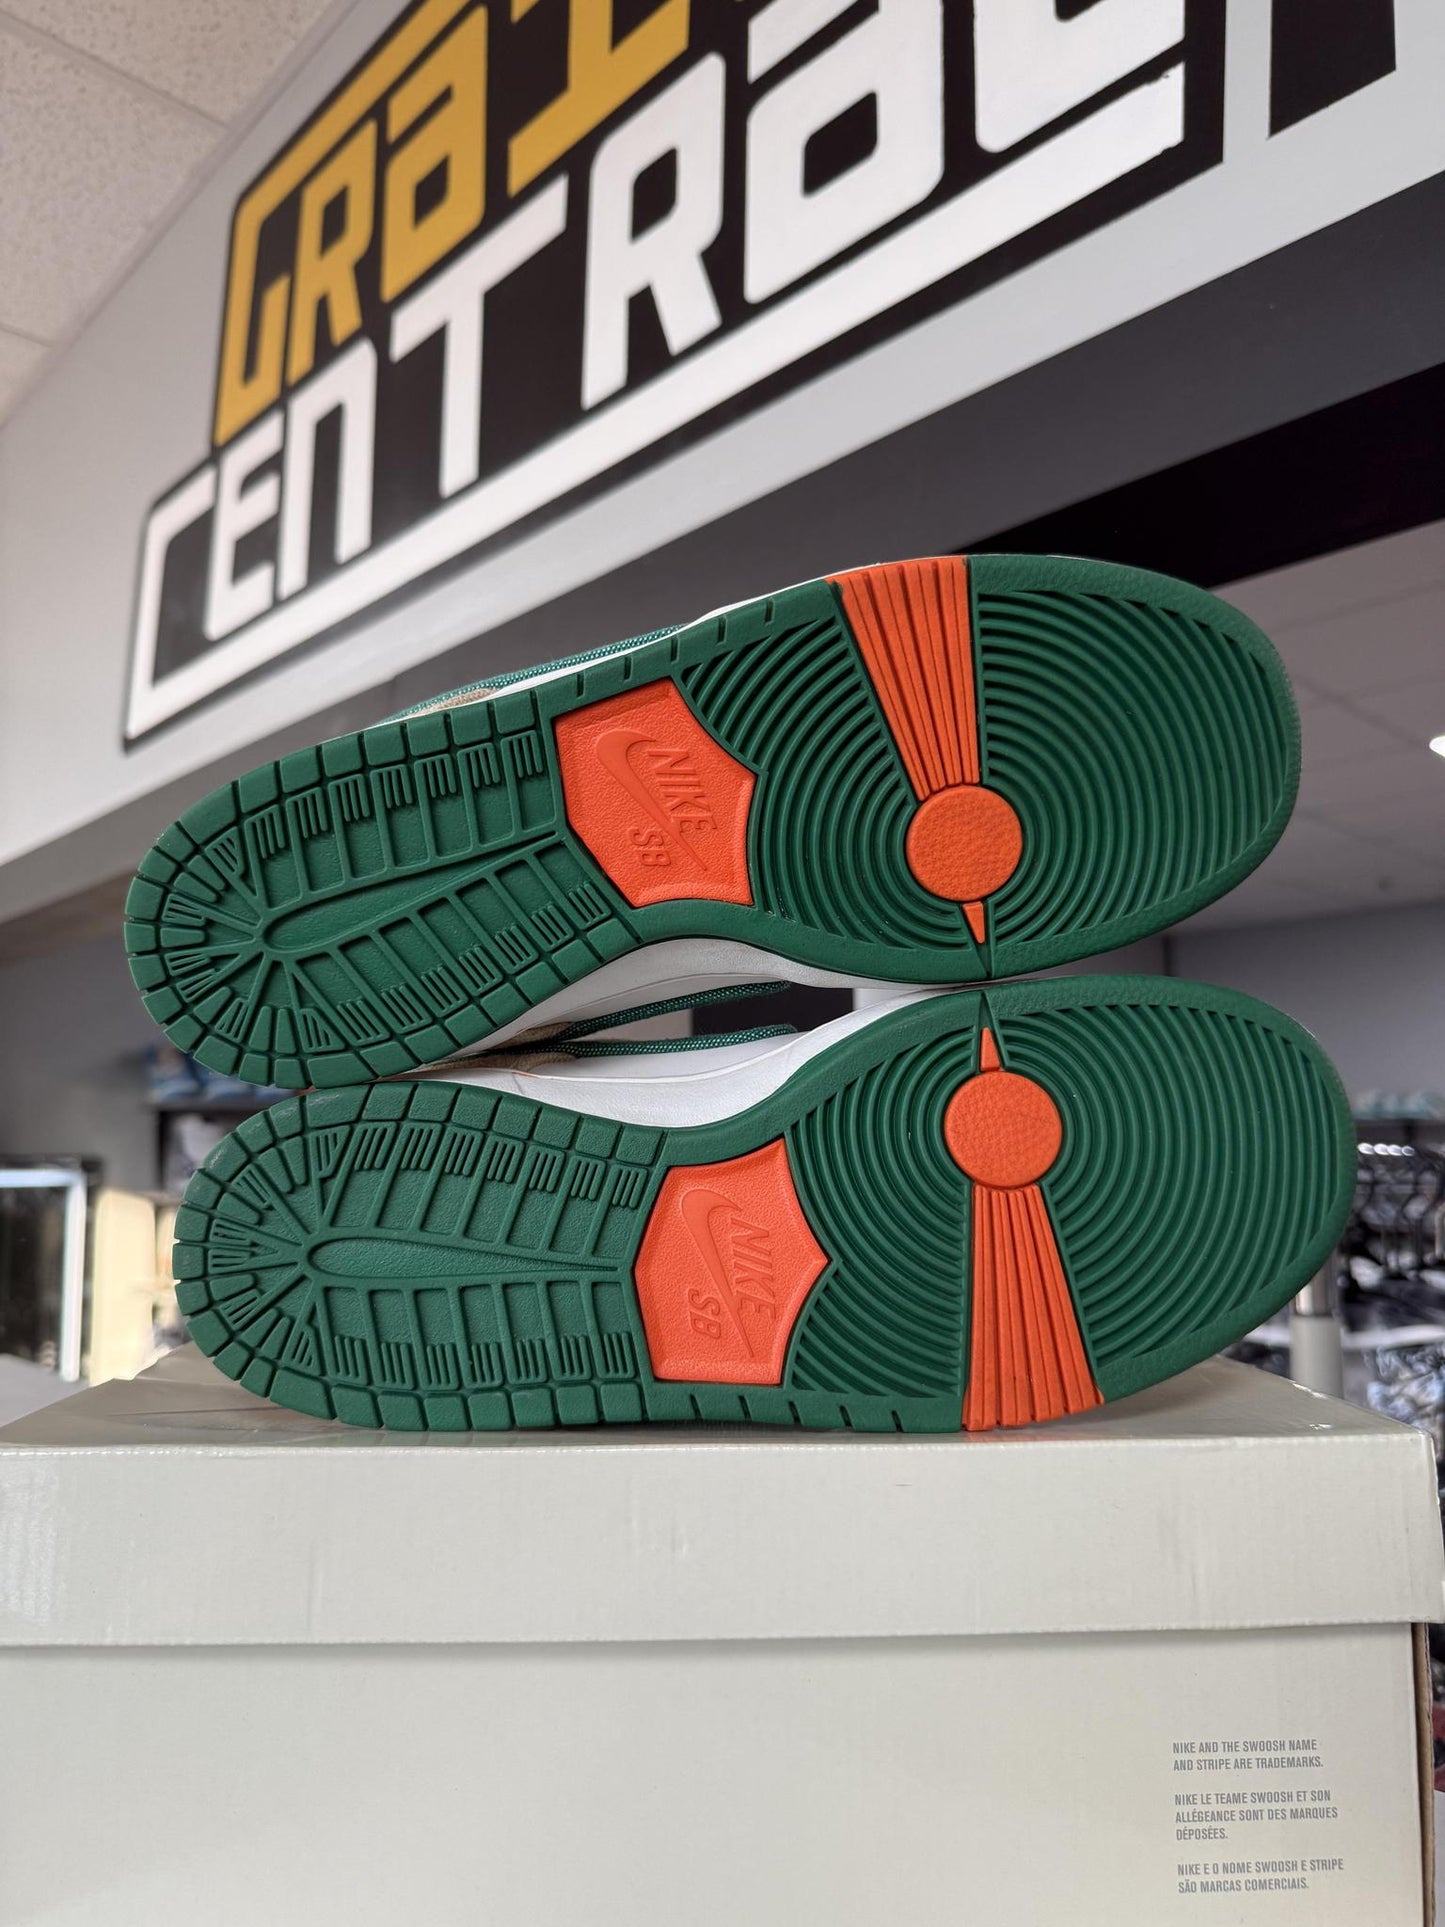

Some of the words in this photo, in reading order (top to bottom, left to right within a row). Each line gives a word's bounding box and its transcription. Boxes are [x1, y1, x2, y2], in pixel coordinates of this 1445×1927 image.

[646, 747, 718, 835] NIKE
[626, 827, 672, 867] SB
[730, 1214, 777, 1321] NIKE
[687, 1288, 722, 1340] SB
[1173, 1742, 1196, 1753] NIKE
[1199, 1742, 1218, 1753] AND
[1221, 1741, 1240, 1752] THE
[1243, 1740, 1285, 1752] SWOOSH
[1289, 1739, 1317, 1751] NAME
[1174, 1760, 1193, 1771] AND
[1197, 1759, 1231, 1770] STRIPE
[1234, 1758, 1252, 1769] ARE
[1255, 1756, 1323, 1768] TRADEMARKS.
[1175, 1794, 1197, 1805] NIKE
[1201, 1794, 1212, 1805] LE
[1214, 1793, 1247, 1804] TEAME
[1251, 1792, 1293, 1803] SWOOSH
[1297, 1791, 1307, 1802] ET
[1311, 1790, 1330, 1801] SON
[1176, 1808, 1236, 1823] ALLÉGEANCE
[1239, 1809, 1264, 1821] SONT
[1268, 1809, 1286, 1820] DES
[1290, 1807, 1337, 1819] MARQUES
[1176, 1825, 1228, 1840] DÉPOSÉES.
[1178, 1864, 1200, 1876] NIKE
[1204, 1864, 1209, 1875] E
[1213, 1863, 1219, 1874] O
[1223, 1862, 1251, 1874] NOME
[1255, 1860, 1297, 1873] SWOOSH
[1301, 1860, 1307, 1871] E
[1310, 1858, 1344, 1871] STRIPE
[1179, 1879, 1197, 1893] SÃO
[1200, 1880, 1241, 1892] MARCAS
[1245, 1877, 1309, 1891] COMERCIAIS.
